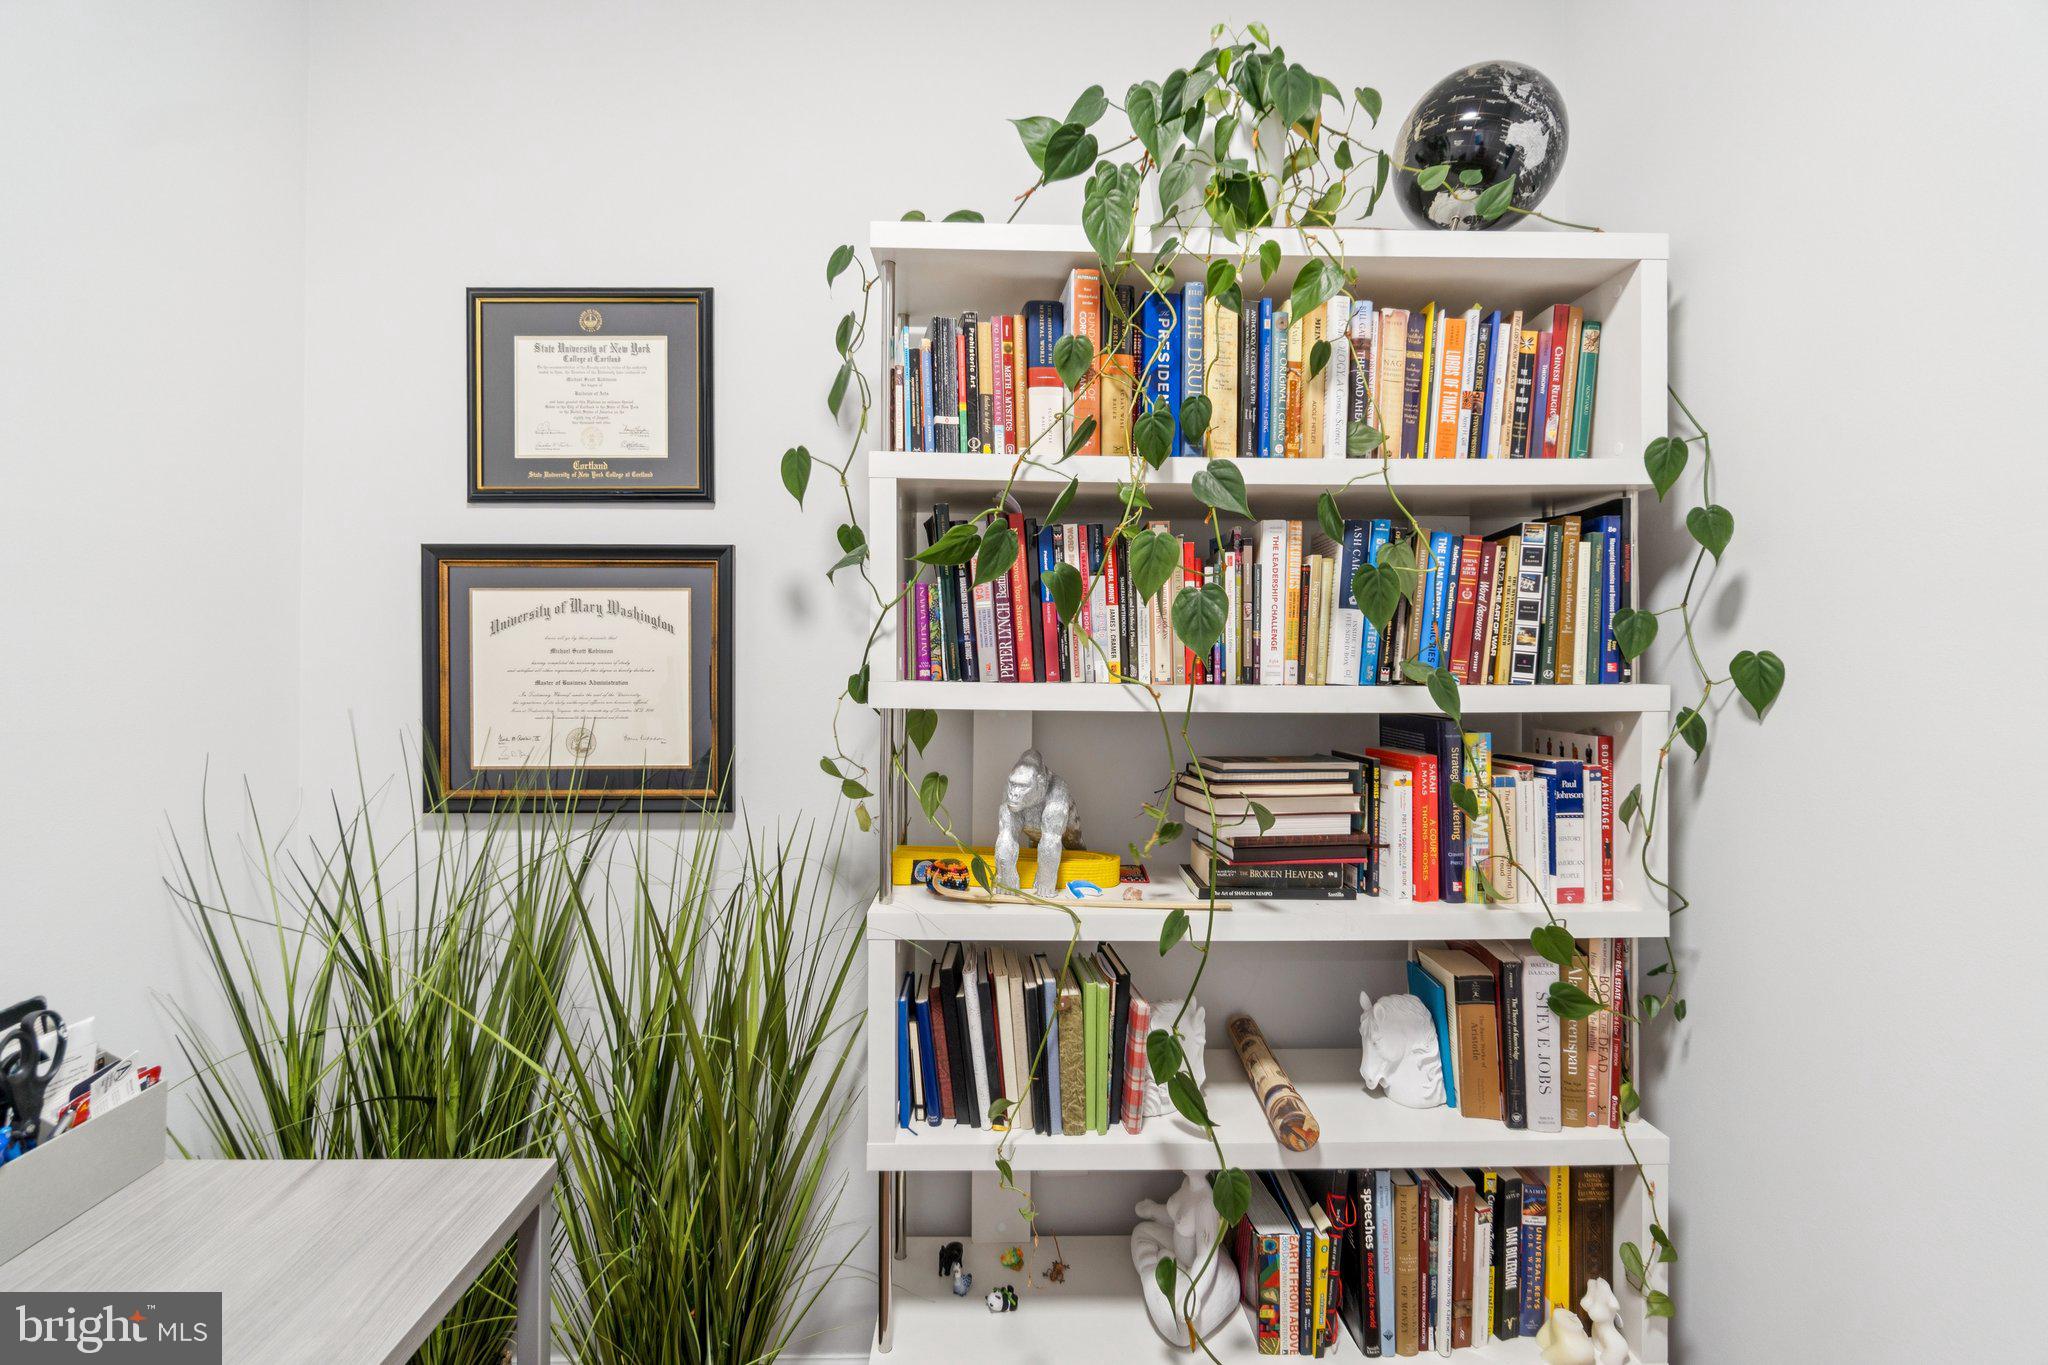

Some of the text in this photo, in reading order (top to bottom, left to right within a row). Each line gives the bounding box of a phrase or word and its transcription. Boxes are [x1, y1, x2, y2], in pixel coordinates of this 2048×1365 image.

[1187, 303, 1202, 339] THE
[534, 343, 651, 355] State University of New York
[563, 355, 586, 363] College
[1250, 348, 1256, 356] OF
[1279, 338, 1287, 354] The
[1477, 343, 1485, 364] GATES
[1476, 365, 1484, 375] OF
[1553, 346, 1563, 381] CHINESE
[1279, 357, 1287, 403] ORIGINAL
[1441, 350, 1460, 423] LORDS OF FINANCE
[544, 471, 570, 480] University
[592, 471, 603, 479] York
[606, 471, 623, 479] College
[573, 461, 608, 470] Cortland
[1354, 526, 1362, 546] ASH
[1289, 524, 1301, 589] FREAKONOMICS
[1451, 545, 1460, 575] Anderson
[1271, 553, 1279, 602] LEADERSHIP
[1497, 571, 1505, 586] TZU
[1447, 582, 1456, 610] Creation
[490, 598, 675, 636] University of Mary Washington
[1016, 605, 1024, 642] Strengths
[1475, 581, 1490, 641] Word Resources
[997, 603, 1014, 678] PETER LYNCH
[1492, 622, 1498, 634] OF
[1427, 643, 1436, 662] RIES
[1601, 744, 1609, 771] BODY
[1554, 790, 1584, 800] Johnson
[1562, 780, 1577, 789] Paul
[1473, 816, 1490, 867] WILL
[1250, 870, 1282, 878] BROKEN
[1284, 870, 1324, 879] HEAVENS
[1470, 1022, 1480, 1061] Aristotle
[1512, 1033, 1520, 1060] Knowledge
[1536, 991, 1552, 1095] STEVE JOBS
[1588, 1065, 1597, 1080] Paul
[1360, 1188, 1375, 1249] speeches
[1505, 1226, 1517, 1290] DAN BILZERIAN
[1289, 1235, 1299, 1355] EARTH FROM ABOVE
[1367, 1268, 1375, 1295] changed
[1400, 1285, 1408, 1334] OF MONEY
